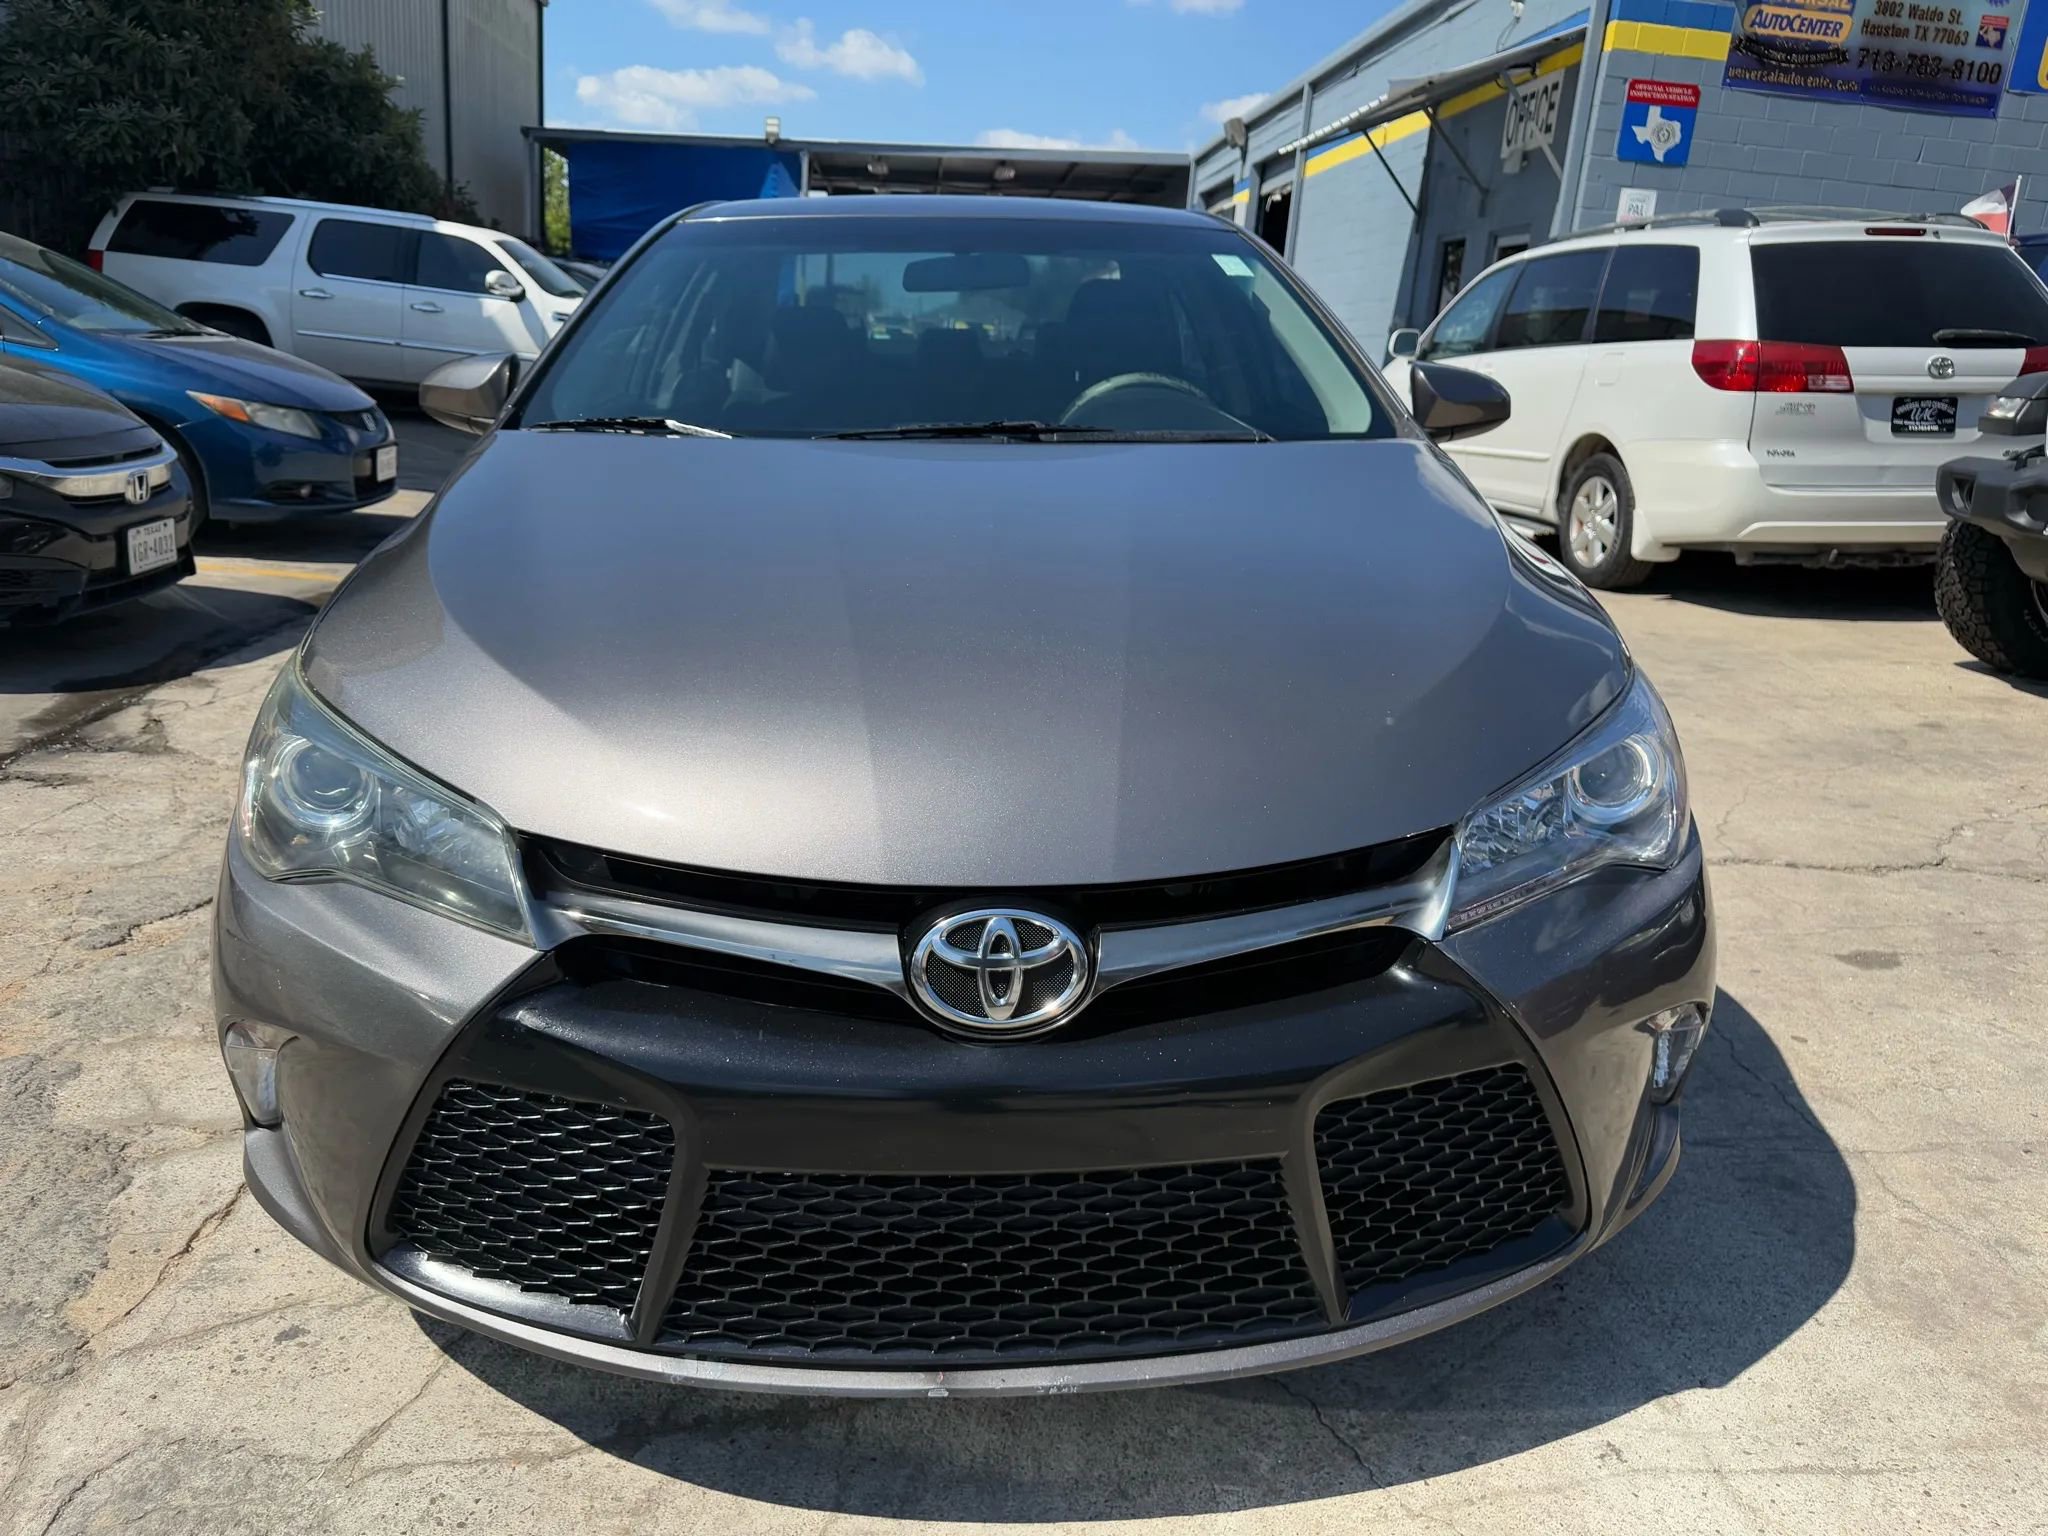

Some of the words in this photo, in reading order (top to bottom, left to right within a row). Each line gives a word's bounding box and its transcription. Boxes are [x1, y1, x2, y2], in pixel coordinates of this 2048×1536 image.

[1750, 9, 1844, 38] AUTOCENTER
[1874, 0, 1905, 18] 3802
[1908, 3, 1944, 21] Waldo
[1861, 19, 1910, 39] Houston
[1915, 25, 1930, 42] TX
[1932, 26, 1969, 47] 77063
